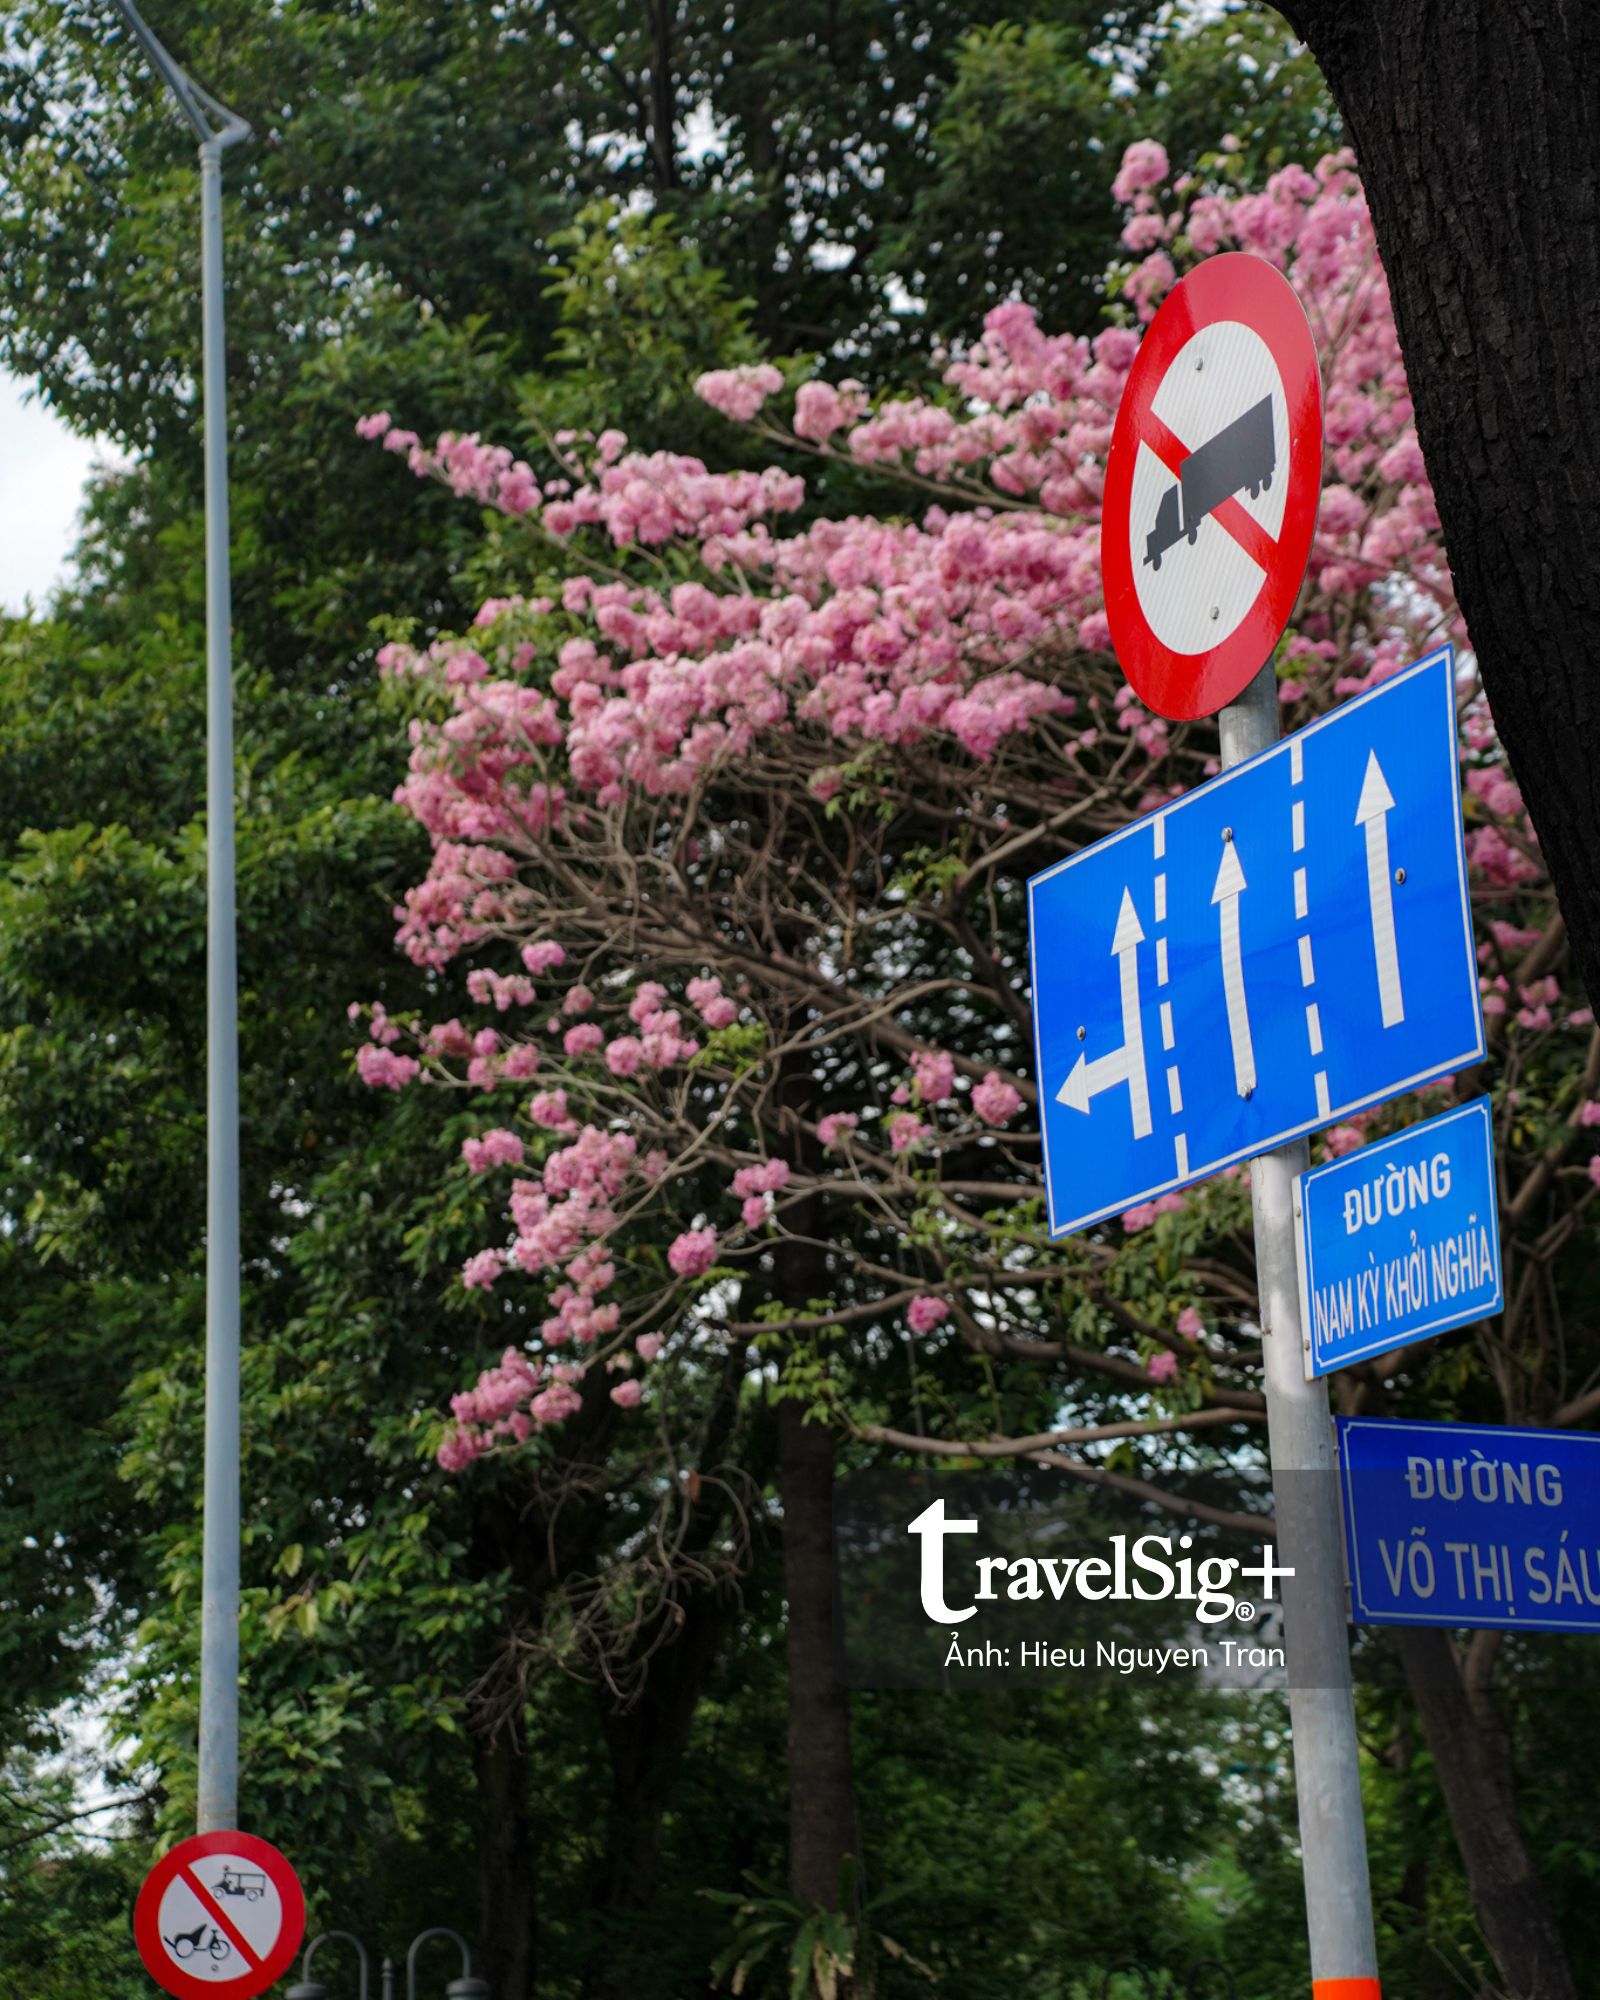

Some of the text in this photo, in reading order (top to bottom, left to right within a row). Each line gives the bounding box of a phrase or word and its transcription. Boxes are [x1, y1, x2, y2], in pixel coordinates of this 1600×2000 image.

[1343, 1152, 1451, 1235] ĐƯỜNG
[1314, 1212, 1494, 1347] NAM KỲ KHỞI NGHĨA
[1404, 1449, 1563, 1507] ĐƯỜNG
[1377, 1526, 1435, 1599] VÕ
[1444, 1542, 1516, 1617] THỊ
